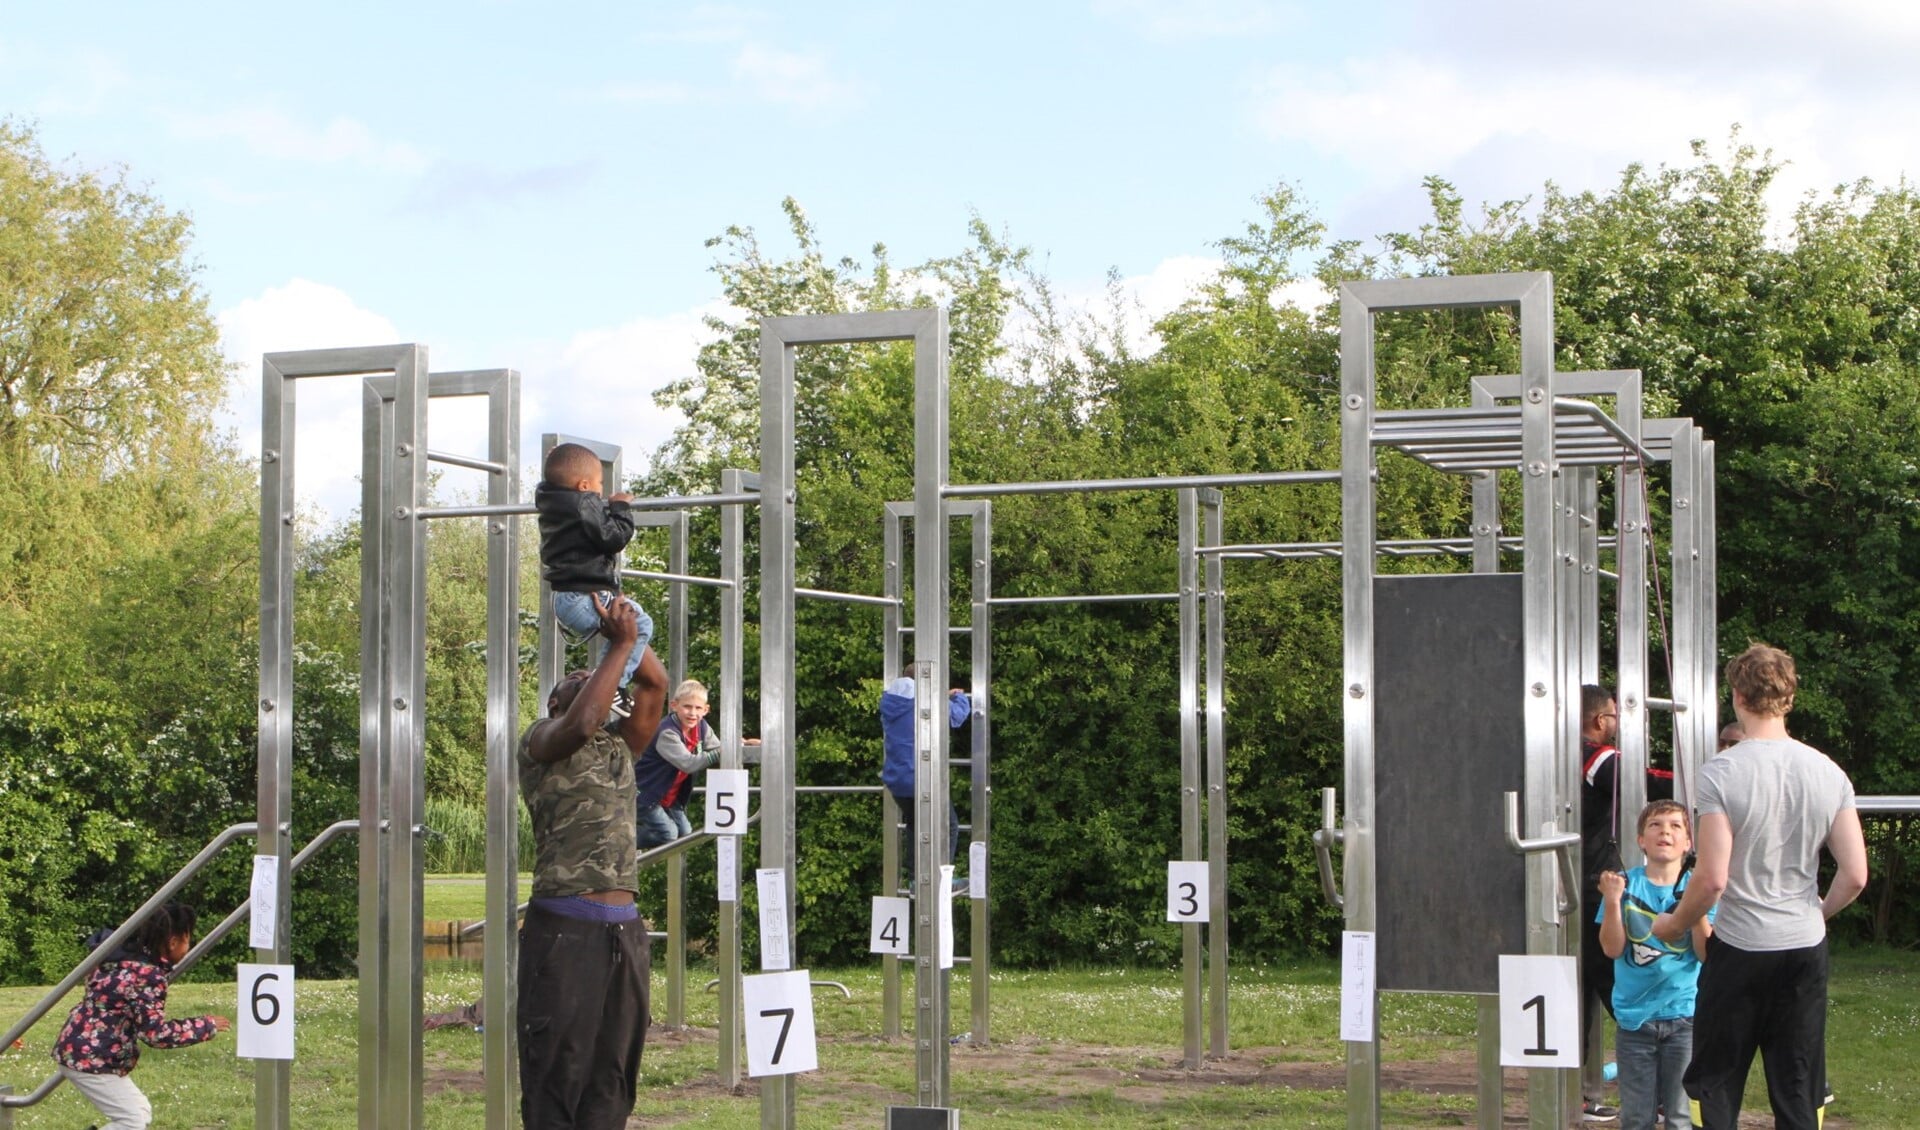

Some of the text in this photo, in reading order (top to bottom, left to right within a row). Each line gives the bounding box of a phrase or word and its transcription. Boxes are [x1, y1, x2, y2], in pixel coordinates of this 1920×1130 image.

[715, 792, 736, 828] 5
[1178, 882, 1199, 917] 3
[879, 916, 902, 948] 4
[251, 973, 280, 1026] 6
[760, 1008, 794, 1065] 7
[1522, 995, 1558, 1056] 1
